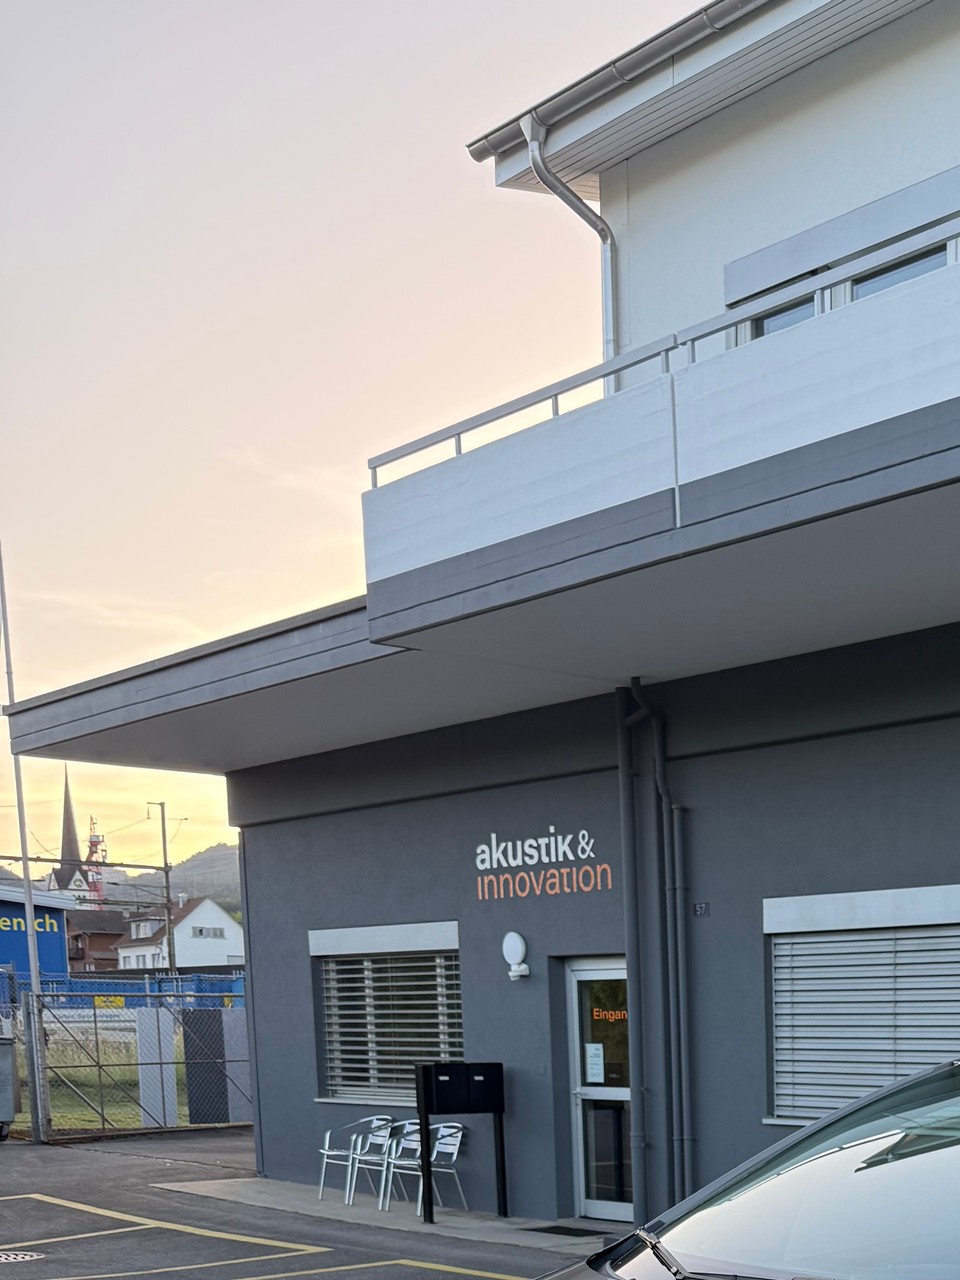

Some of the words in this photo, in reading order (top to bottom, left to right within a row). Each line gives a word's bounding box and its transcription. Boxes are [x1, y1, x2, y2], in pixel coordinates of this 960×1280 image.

[476, 825, 575, 870] akustik
[578, 829, 596, 859] &
[477, 863, 612, 900] innovation
[0, 914, 58, 932] ench
[593, 1007, 628, 1022] Eingan
